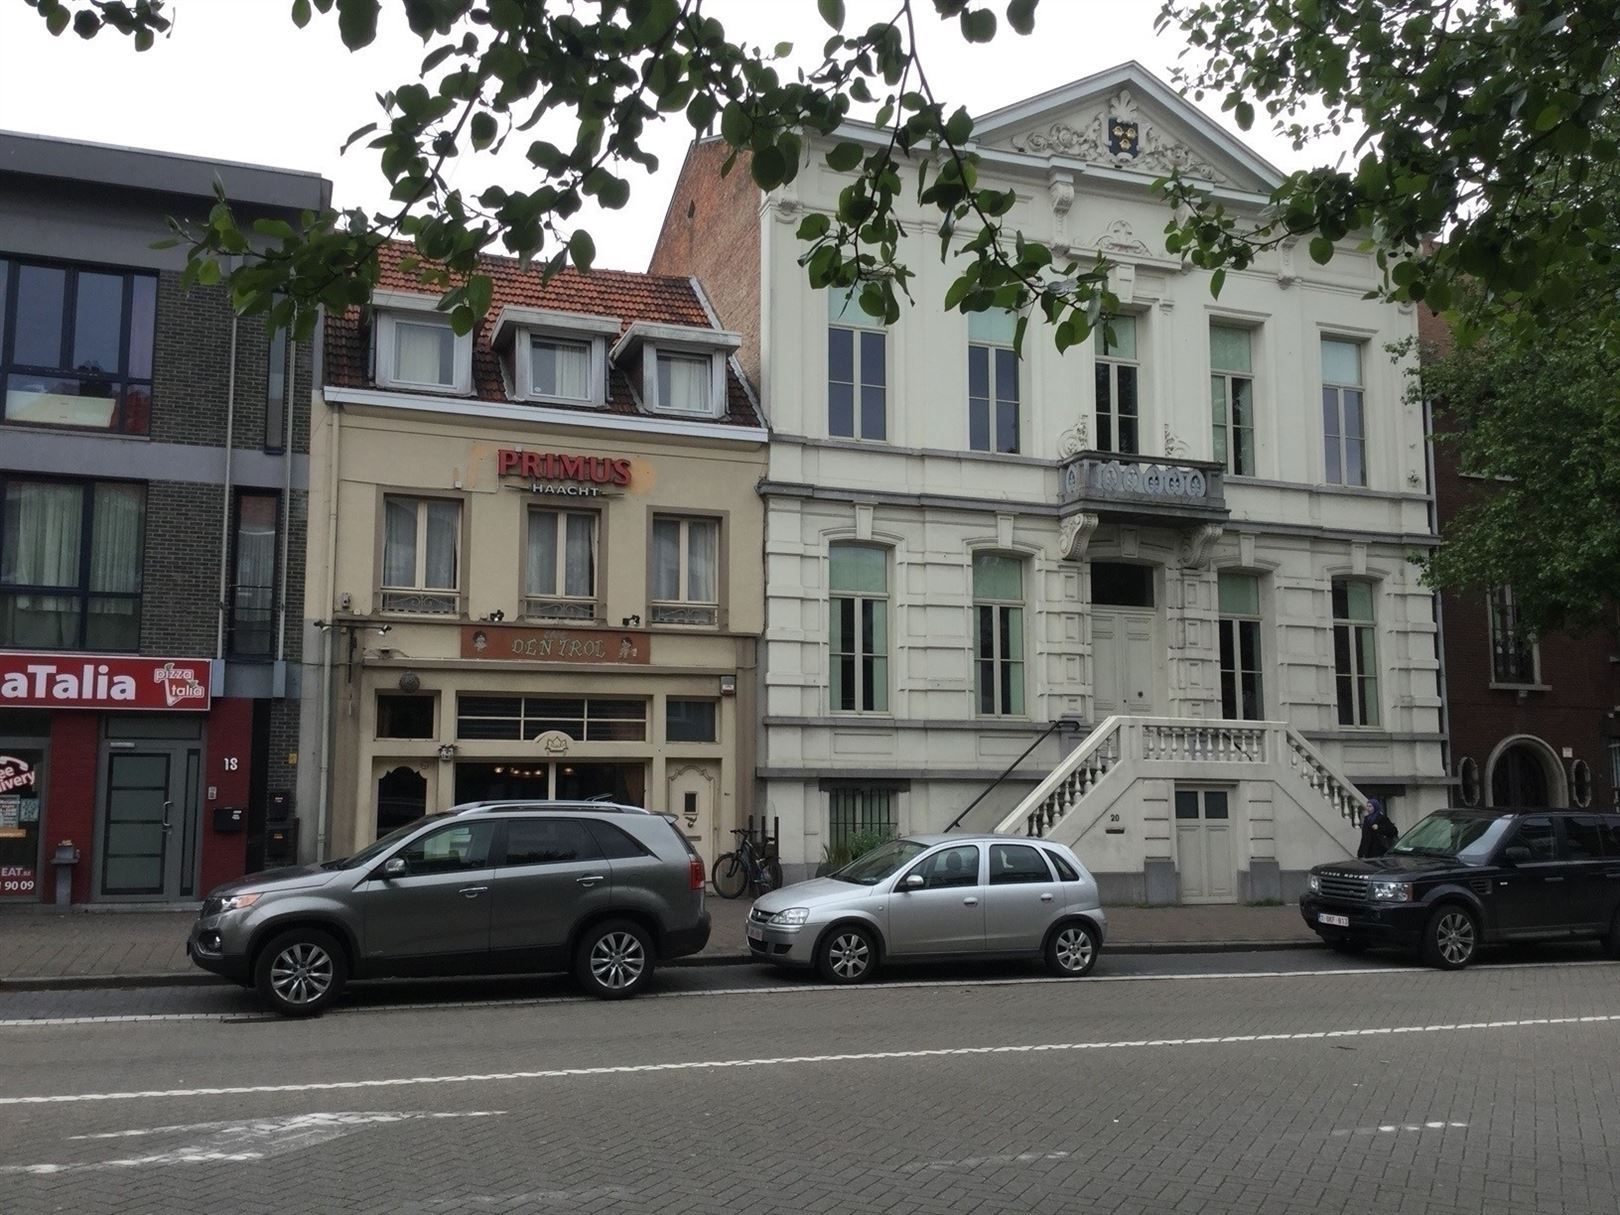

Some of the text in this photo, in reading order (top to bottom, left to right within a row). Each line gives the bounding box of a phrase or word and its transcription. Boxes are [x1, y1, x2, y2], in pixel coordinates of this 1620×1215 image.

[498, 449, 632, 486] PRIMUS
[532, 483, 599, 496] HAACHT
[512, 638, 553, 656] DEN
[0, 664, 137, 700] aTalia
[156, 669, 193, 682] pizza
[171, 684, 203, 697] talia
[1110, 813, 1120, 822] 20
[4, 880, 18, 891] 90
[20, 880, 34, 890] 09
